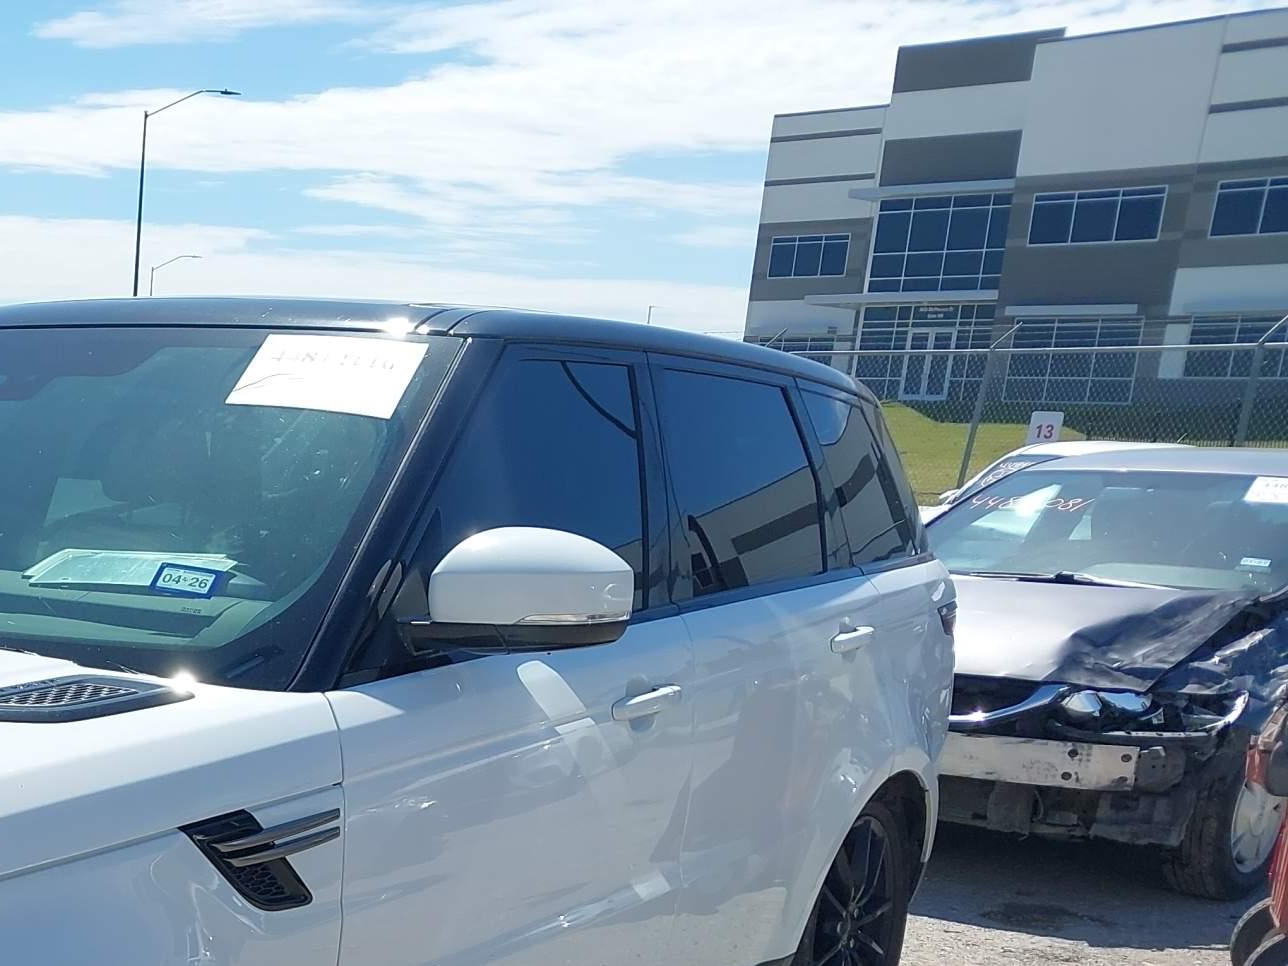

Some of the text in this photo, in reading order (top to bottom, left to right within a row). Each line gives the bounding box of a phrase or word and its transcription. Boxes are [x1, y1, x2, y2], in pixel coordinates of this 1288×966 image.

[1036, 424, 1054, 440] 13
[969, 495, 1096, 512] 448081
[162, 573, 182, 585] 04
[188, 577, 209, 589] 26
